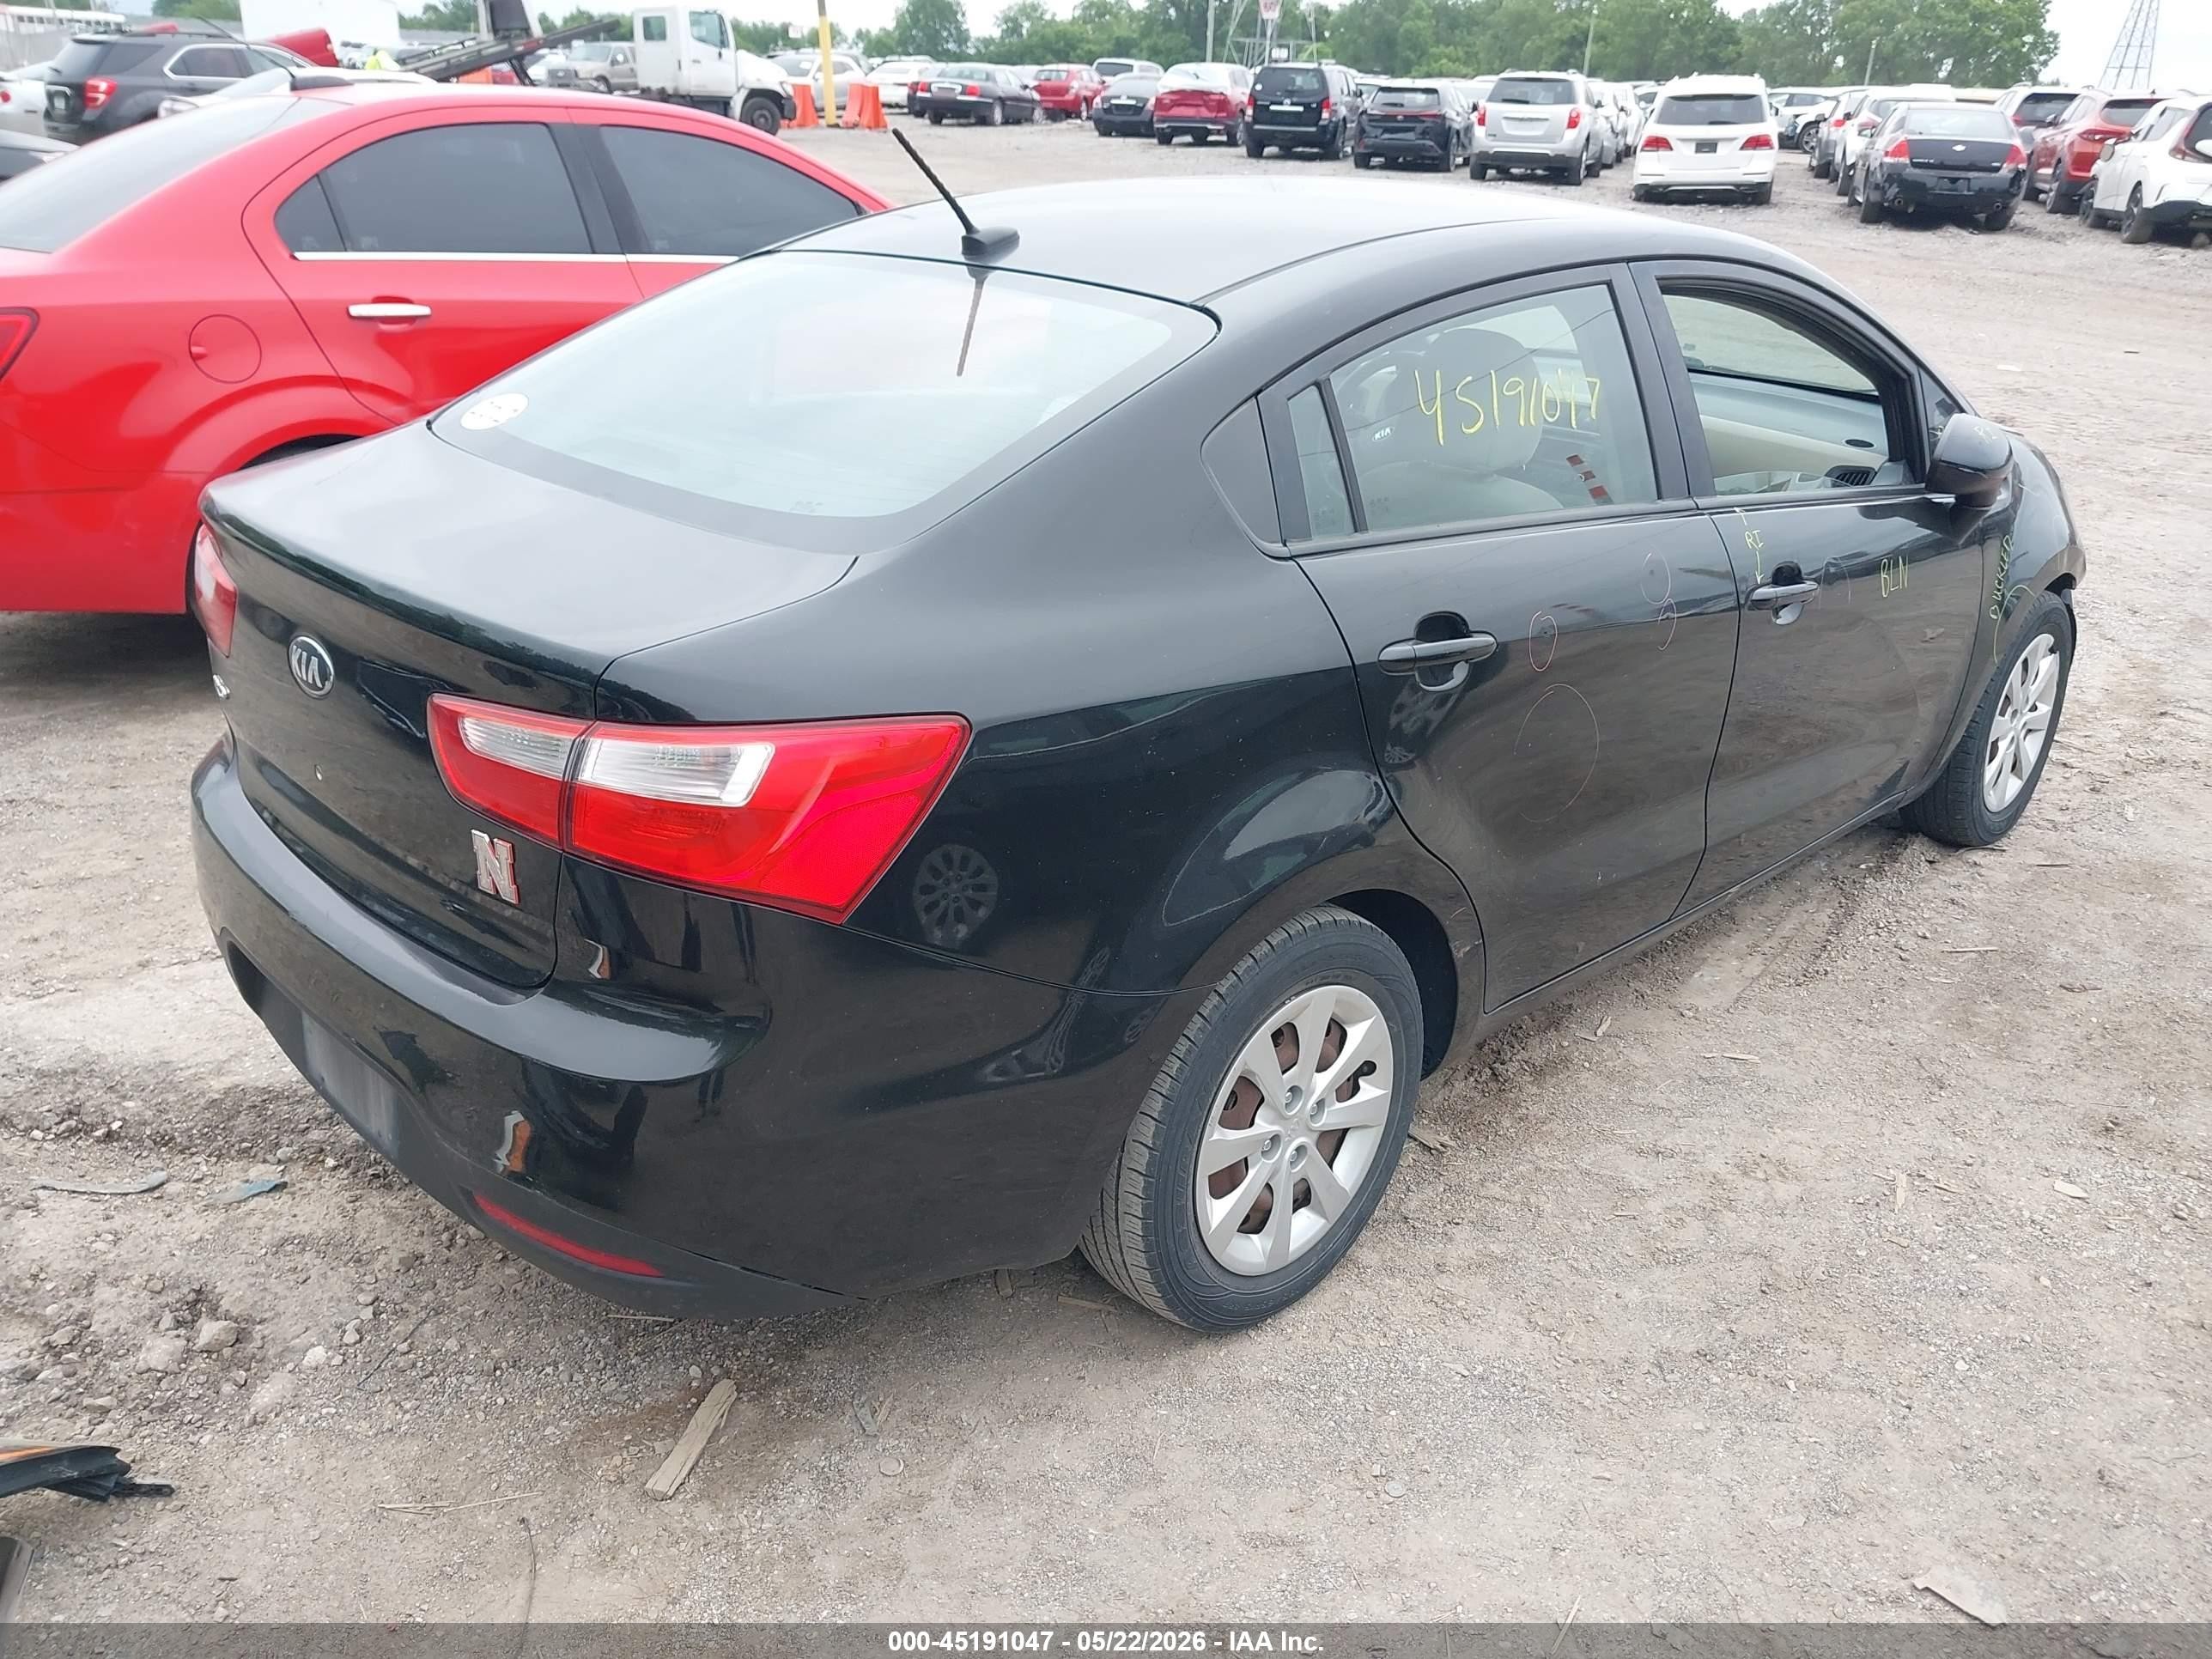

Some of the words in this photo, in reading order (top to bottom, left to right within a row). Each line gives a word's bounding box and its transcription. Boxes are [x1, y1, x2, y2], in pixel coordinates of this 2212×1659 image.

[1374, 427, 1392, 441] KIA
[1413, 367, 1601, 446] 45191047
[290, 643, 321, 689] KIA
[470, 829, 521, 905] N
